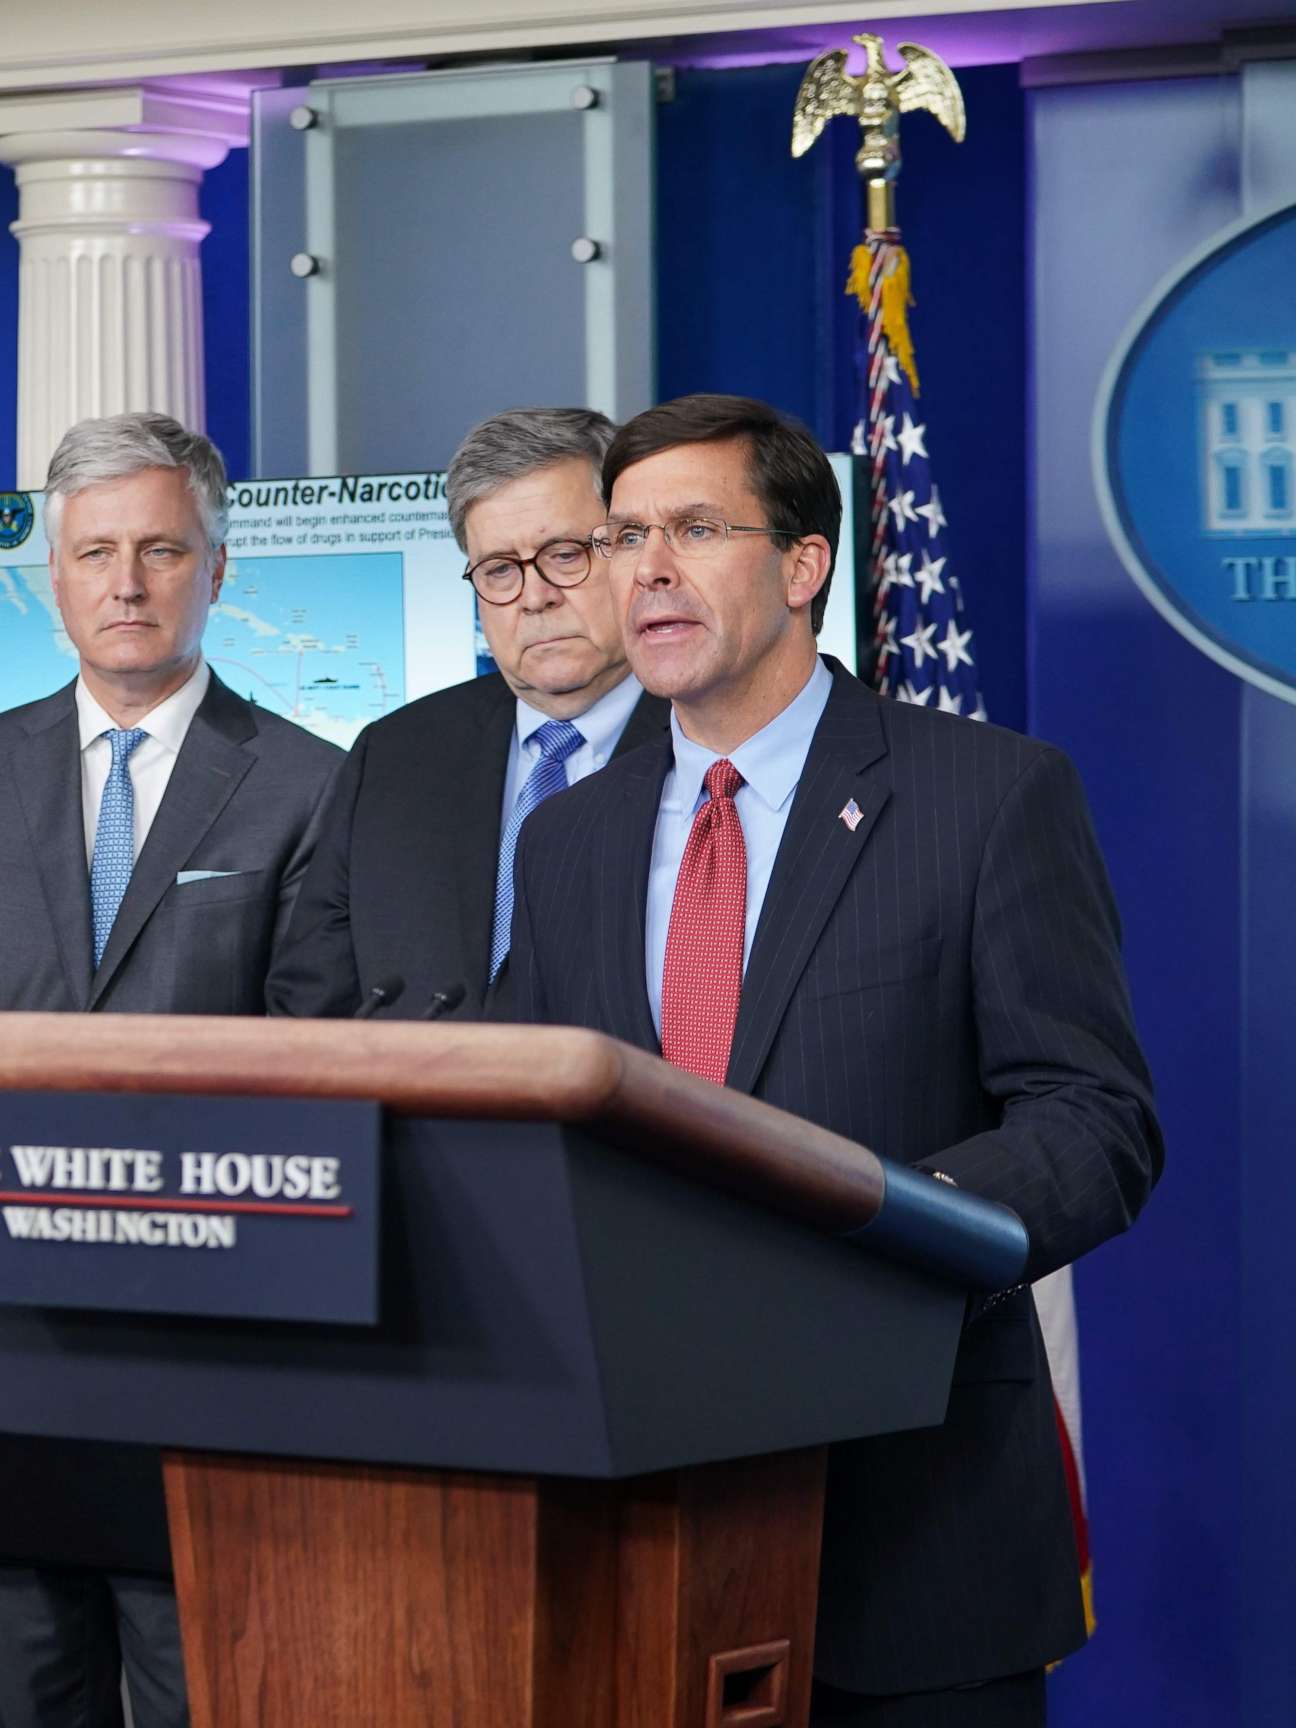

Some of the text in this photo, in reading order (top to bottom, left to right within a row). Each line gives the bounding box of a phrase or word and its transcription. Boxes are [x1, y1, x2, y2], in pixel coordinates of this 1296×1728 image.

[276, 515, 292, 527] will
[296, 515, 326, 529] begin
[329, 512, 386, 525] enhanced
[251, 533, 267, 546] the
[271, 533, 293, 546] flow
[296, 532, 307, 545] of
[310, 532, 342, 547] drugs
[346, 531, 355, 543] in
[359, 529, 402, 545] support
[405, 529, 415, 541] of
[10, 1145, 164, 1192] WHITE
[180, 1152, 341, 1200] HOUSE
[2, 1206, 236, 1249] WASHINGTON
